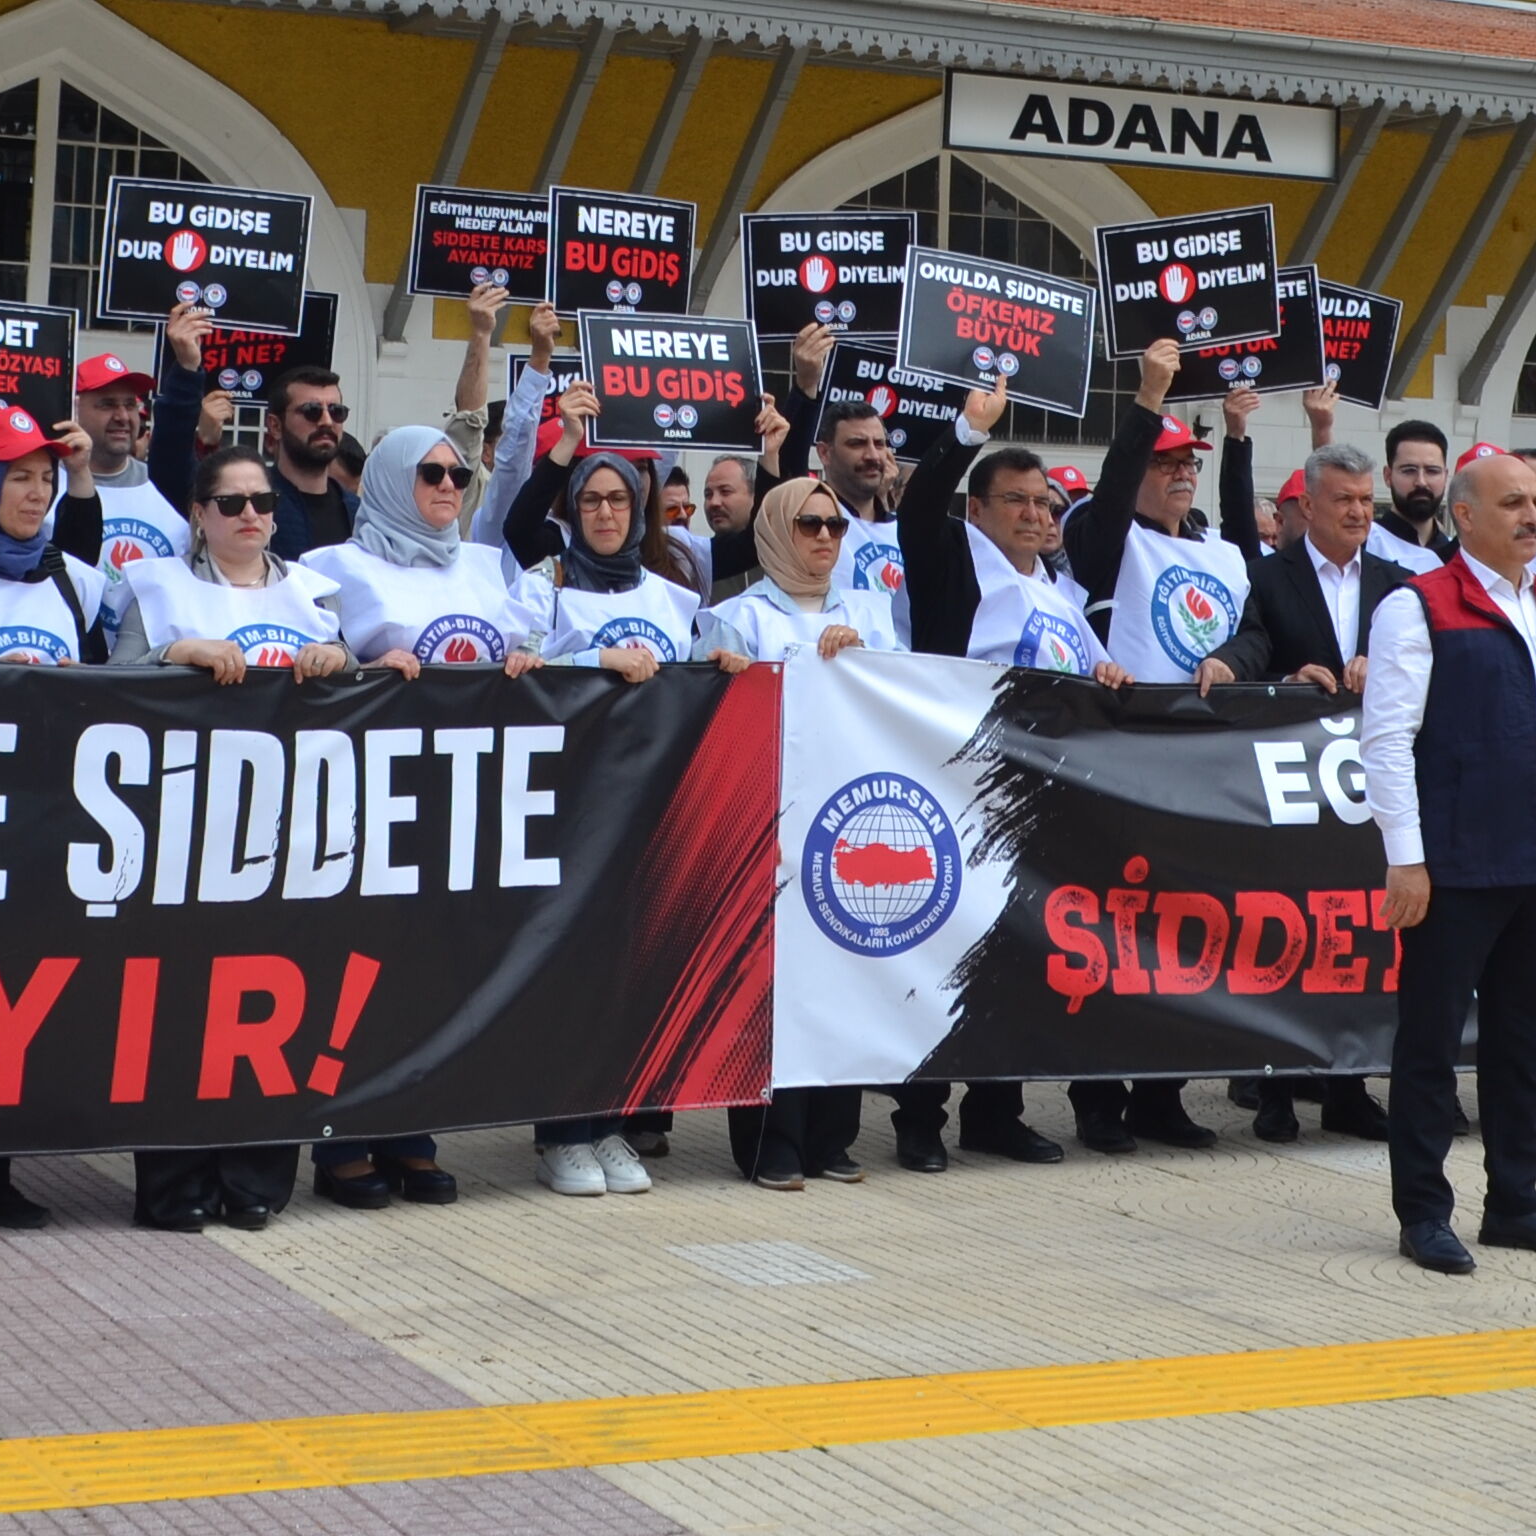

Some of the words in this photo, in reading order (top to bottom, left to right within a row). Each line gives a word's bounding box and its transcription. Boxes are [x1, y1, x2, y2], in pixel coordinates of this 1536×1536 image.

[1009, 94, 1272, 163] ADANA
[147, 201, 184, 225] BU
[189, 205, 271, 236] GİDİŞE
[429, 201, 472, 216] EĞİTİM
[577, 205, 676, 243] NEREYE
[432, 230, 500, 250] ŞİDDETE
[455, 218, 498, 232] HEDEF
[500, 221, 533, 235] ALAN
[779, 233, 811, 253] BU
[816, 230, 885, 254] GİDİŞE
[117, 239, 163, 261] DUR
[210, 244, 294, 273] DİYELİM
[447, 249, 535, 270] AYAKTAYIZ
[565, 240, 608, 273] BU
[611, 246, 681, 287] GİDİŞ
[1136, 241, 1169, 264] BU
[1173, 229, 1242, 259] GİDİŞE
[756, 269, 797, 287] DUR
[838, 266, 905, 285] DİYELİM
[919, 261, 1001, 295] OKULDA
[1005, 278, 1084, 316] ŞİDDETE
[1115, 280, 1158, 303] DUR
[1197, 262, 1266, 291] DİYELİM
[946, 287, 1056, 335] ÖFKEMİZ
[611, 329, 730, 362] NEREYE
[956, 316, 1041, 358] BÜYÜK
[1185, 330, 1212, 342] ADANA
[1324, 340, 1362, 359] NE?
[236, 343, 286, 365] NE?
[857, 360, 884, 379] BU
[602, 366, 651, 397] BU
[656, 368, 745, 407] GİDİŞ
[897, 399, 957, 422] DİYELİM
[663, 428, 692, 439] ADANA
[69, 723, 567, 919] ŞİDDETE
[820, 779, 946, 835] MEMUR-SEN
[811, 851, 826, 903] MEMUR
[885, 854, 953, 948] KONFEDERASYONU
[817, 902, 884, 949] SENDİKALARI
[869, 927, 890, 937] 1995
